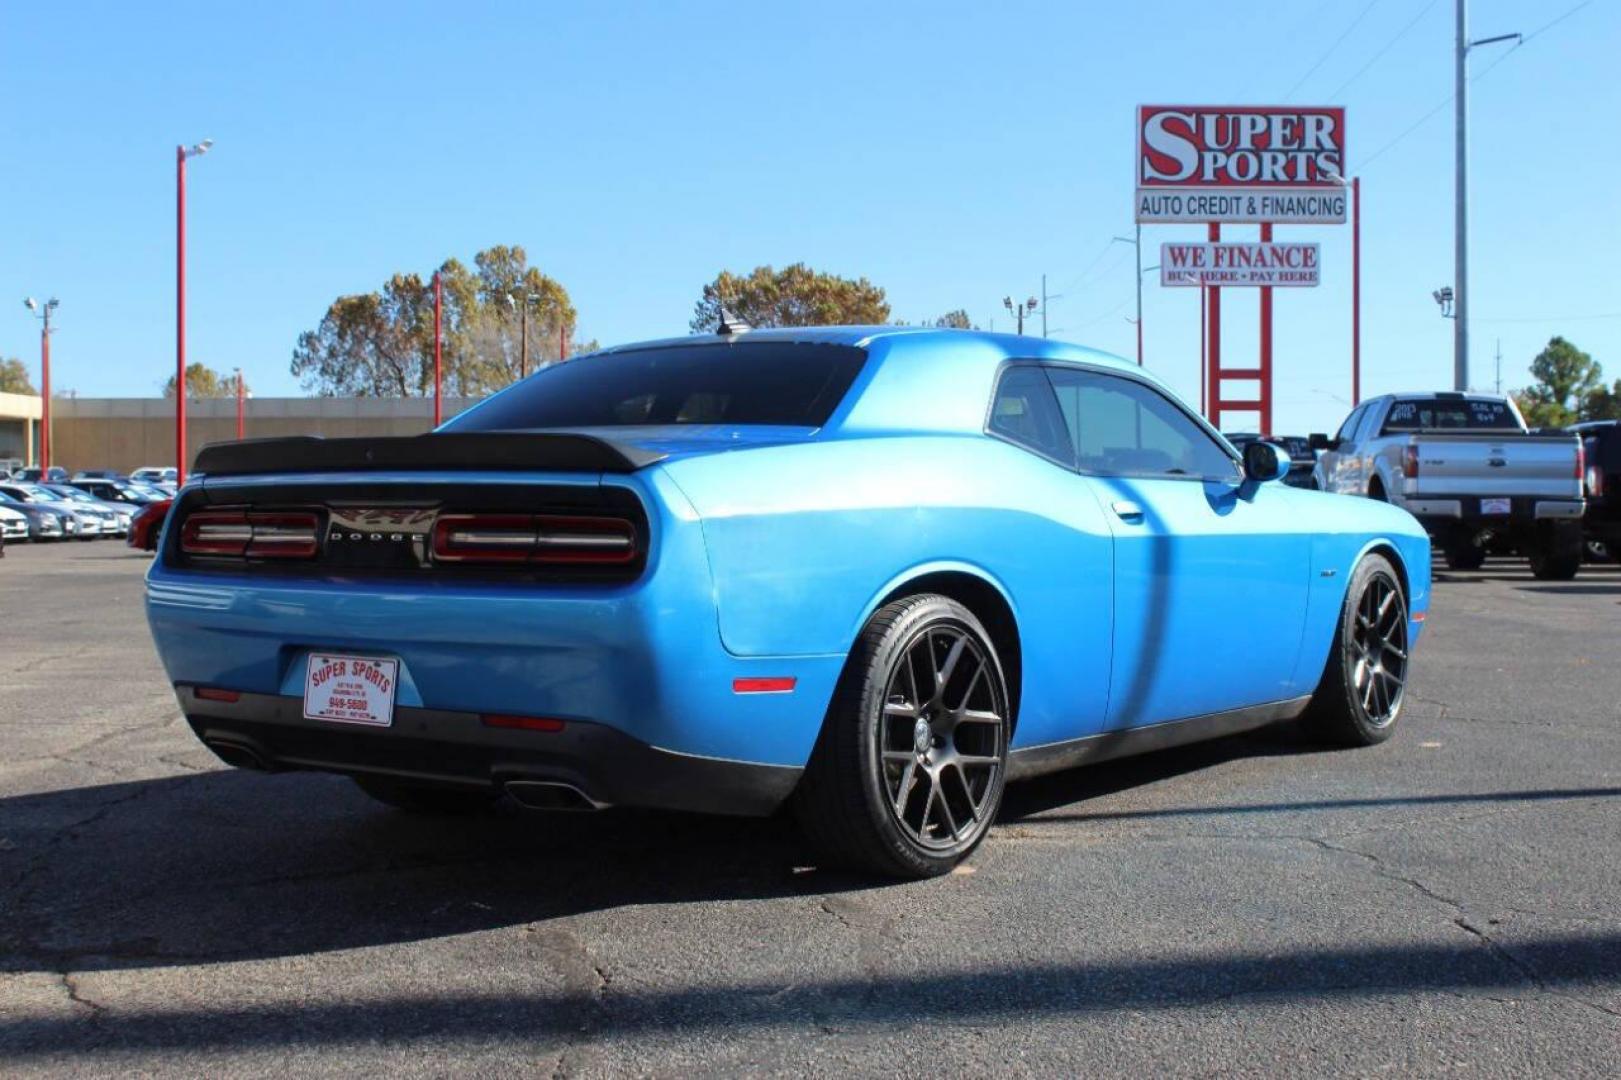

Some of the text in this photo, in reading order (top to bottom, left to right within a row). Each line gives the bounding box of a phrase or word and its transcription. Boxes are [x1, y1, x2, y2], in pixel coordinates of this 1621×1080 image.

[1144, 111, 1339, 182] SUPER
[1140, 196, 1344, 216] AUTO CREDIT & FINANCING
[1168, 246, 1317, 268] WE FINANCE
[1168, 271, 1317, 282] BUY HERE PAY HERE
[331, 533, 424, 541] DODGE
[312, 661, 390, 693] SUPER SPORTS
